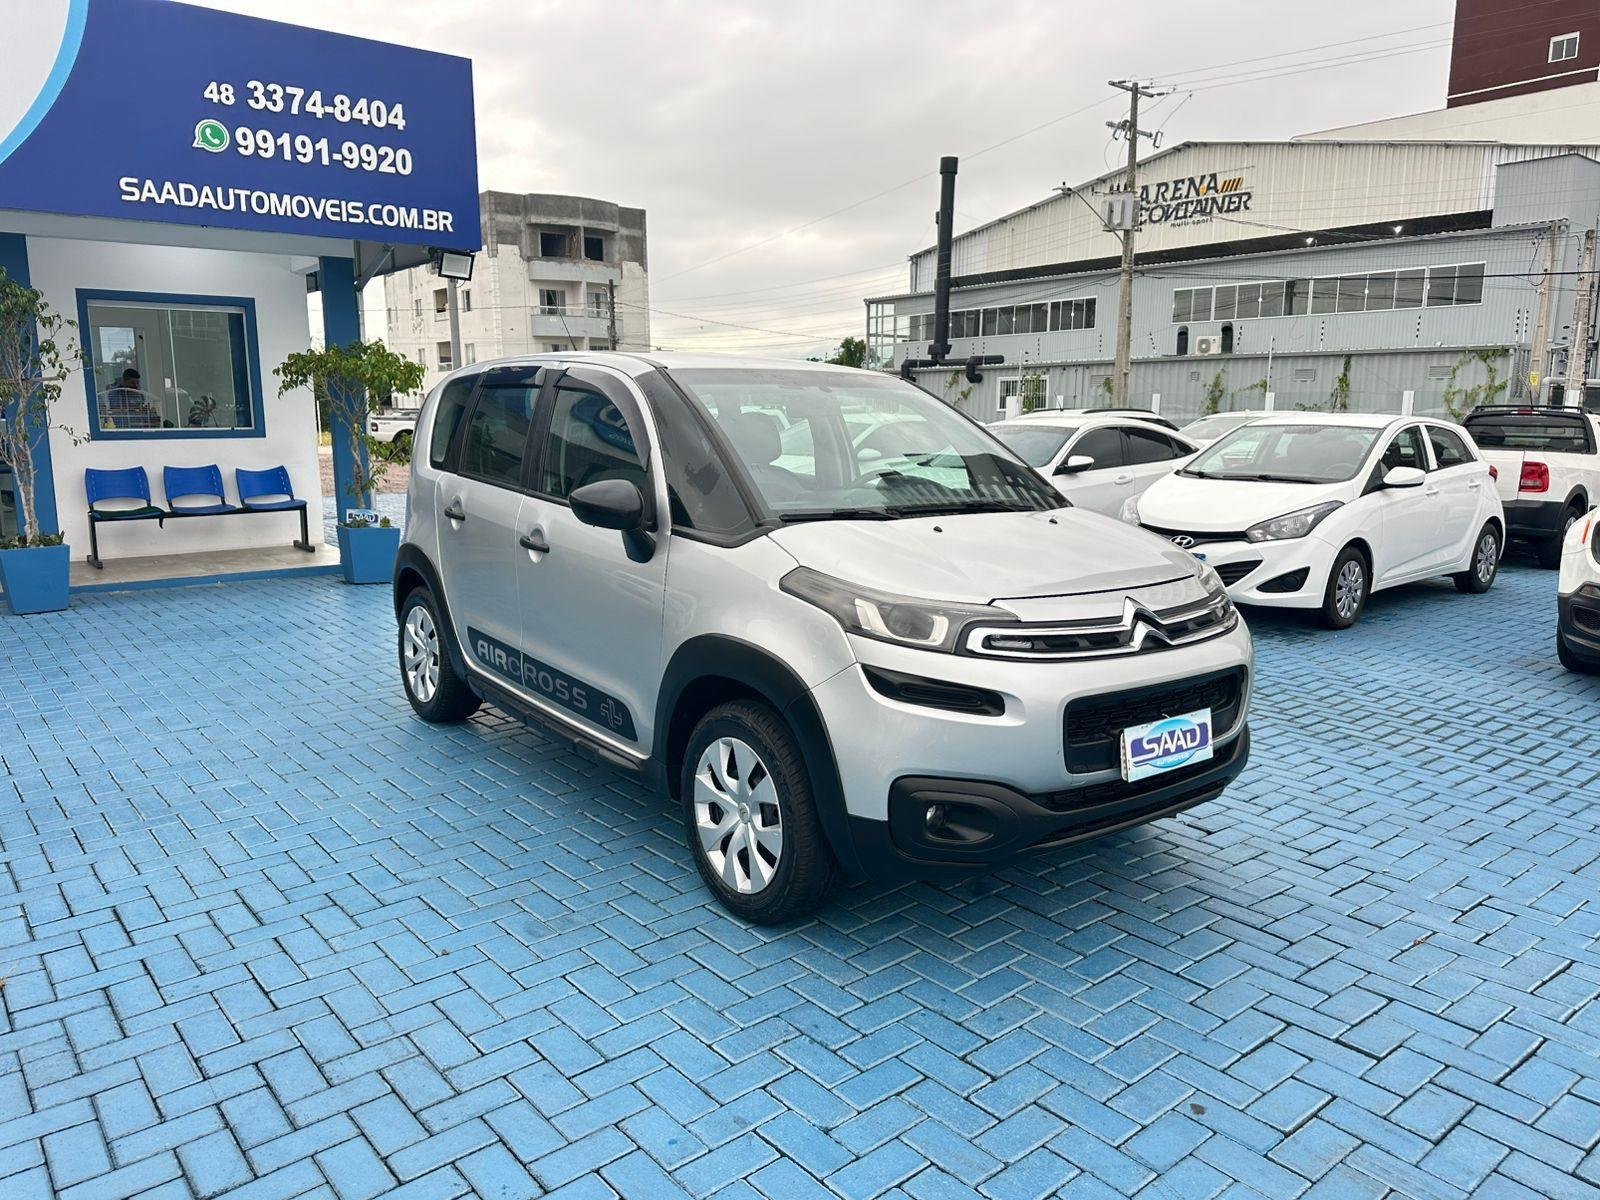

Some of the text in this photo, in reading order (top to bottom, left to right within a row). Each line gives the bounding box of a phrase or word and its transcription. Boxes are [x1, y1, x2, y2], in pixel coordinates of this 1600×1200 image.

[203, 79, 406, 131] 48 3374-8404
[235, 127, 413, 176] 99191-9920
[119, 177, 453, 233] SAADAUTOMOVEIS.COM.BR
[1140, 172, 1221, 205] ARENA
[477, 639, 588, 710] AIRCROSS
[1142, 722, 1201, 758] SAAD
